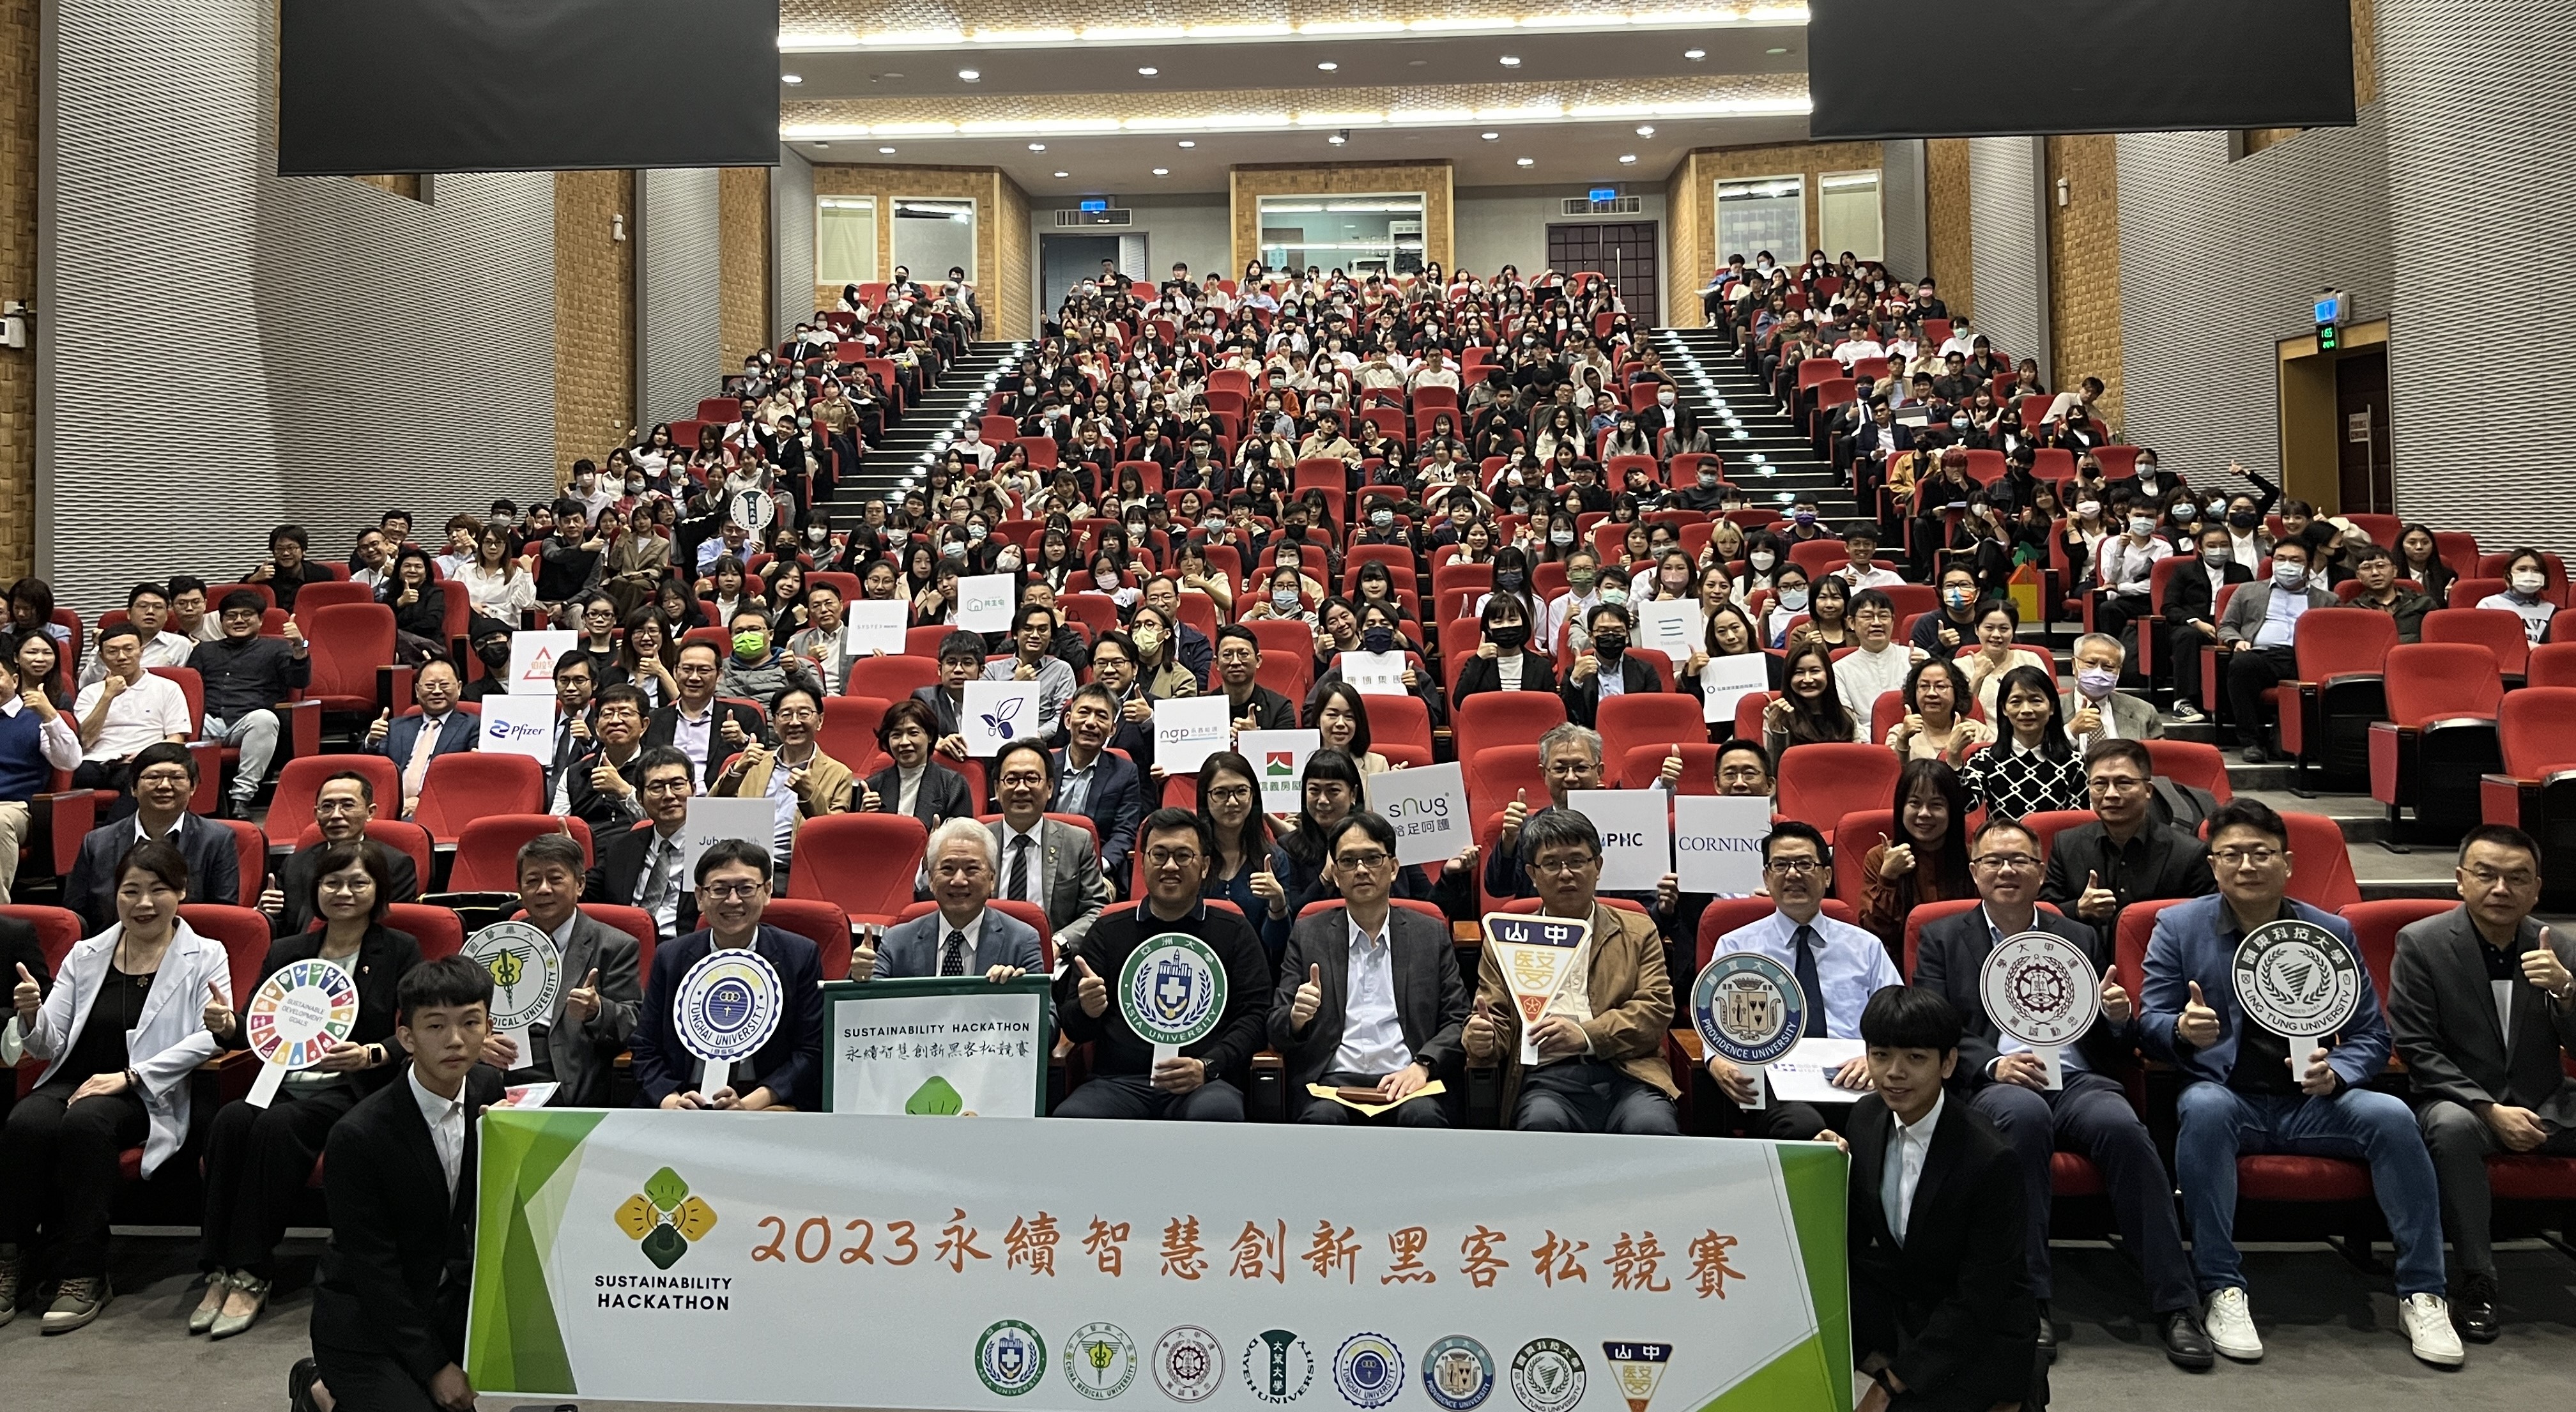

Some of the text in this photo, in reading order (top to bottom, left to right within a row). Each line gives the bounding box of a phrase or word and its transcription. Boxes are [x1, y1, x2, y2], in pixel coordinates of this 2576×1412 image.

[511, 723, 545, 741] Pfizer
[1160, 729, 1189, 744] ngp
[490, 971, 556, 1027] DICAL UNIVERSITY
[2245, 989, 2351, 1031] LING TUNG UNIVERSITY
[691, 1000, 765, 1046] TUNGHAI UNIVERSITY
[844, 1022, 1030, 1038] SUSTAINABILITY HACKATHON
[1125, 1001, 1216, 1042] ASIA UNIVERSITY
[845, 1040, 1030, 1063] 永續智慧創新黑客松競賽
[1701, 1018, 1797, 1059] PROVIDENCE UNIVERSITY
[595, 1275, 732, 1290] SUSTAINABILITY
[597, 1293, 729, 1310] HACKATHON
[995, 1369, 1043, 1396] UNIVERSITY
[1065, 1361, 1135, 1398] CHINA MEDICAL UNIVERSITY
[1243, 1338, 1315, 1404] DAYEH UNIVERSITY
[1342, 1366, 1395, 1399] TUNGHAI UNIVERSITY
[1426, 1379, 1491, 1409] PROVIDENCE UNIVERSITY
[1515, 1382, 1527, 1400] LING
[1527, 1398, 1546, 1412] TUNG
[1547, 1385, 1582, 1412] UNIVERSITY
